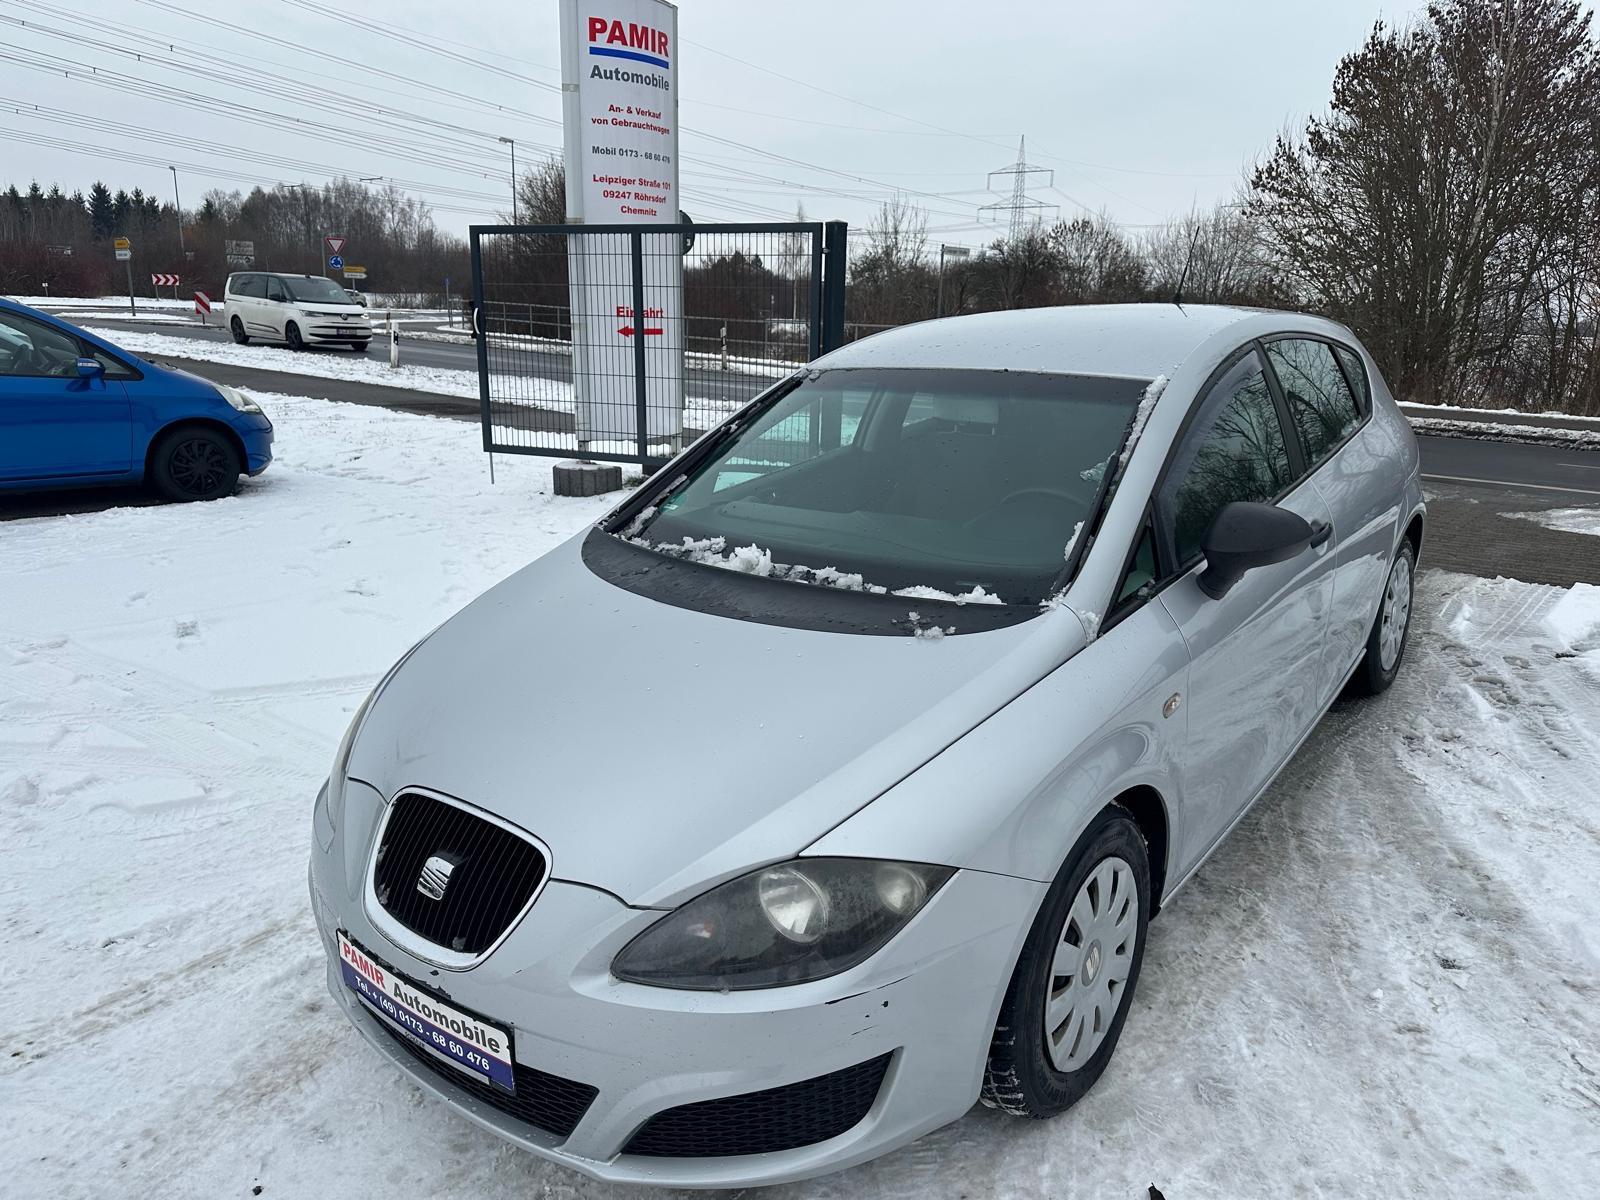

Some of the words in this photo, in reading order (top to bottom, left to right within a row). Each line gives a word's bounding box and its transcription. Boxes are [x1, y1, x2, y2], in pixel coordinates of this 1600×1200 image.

[588, 17, 669, 57] PAMIR
[590, 65, 669, 91] Automobile
[608, 104, 624, 113] An-
[626, 106, 633, 114] &
[635, 107, 662, 120] Verkauf
[591, 117, 608, 125] von
[611, 118, 670, 135] Gebrauchtwagen
[592, 146, 616, 156] Mobil
[618, 148, 639, 158] 0173
[644, 152, 653, 160] 68
[592, 174, 636, 186] Leipziger
[638, 178, 661, 189] Straße
[662, 182, 671, 191] 101
[603, 190, 632, 199] 09247
[634, 192, 666, 204] Röhrsdorf
[620, 205, 657, 216] Chemnitz
[616, 306, 664, 318] Einahrt
[343, 941, 386, 990] PAMIR
[393, 982, 500, 1053] Automobile
[355, 975, 371, 996] Tel.
[379, 995, 397, 1019] (49)
[399, 1010, 424, 1034] 0173
[432, 1031, 446, 1047] 68
[449, 1040, 464, 1057] 60
[466, 1051, 490, 1071] 476
